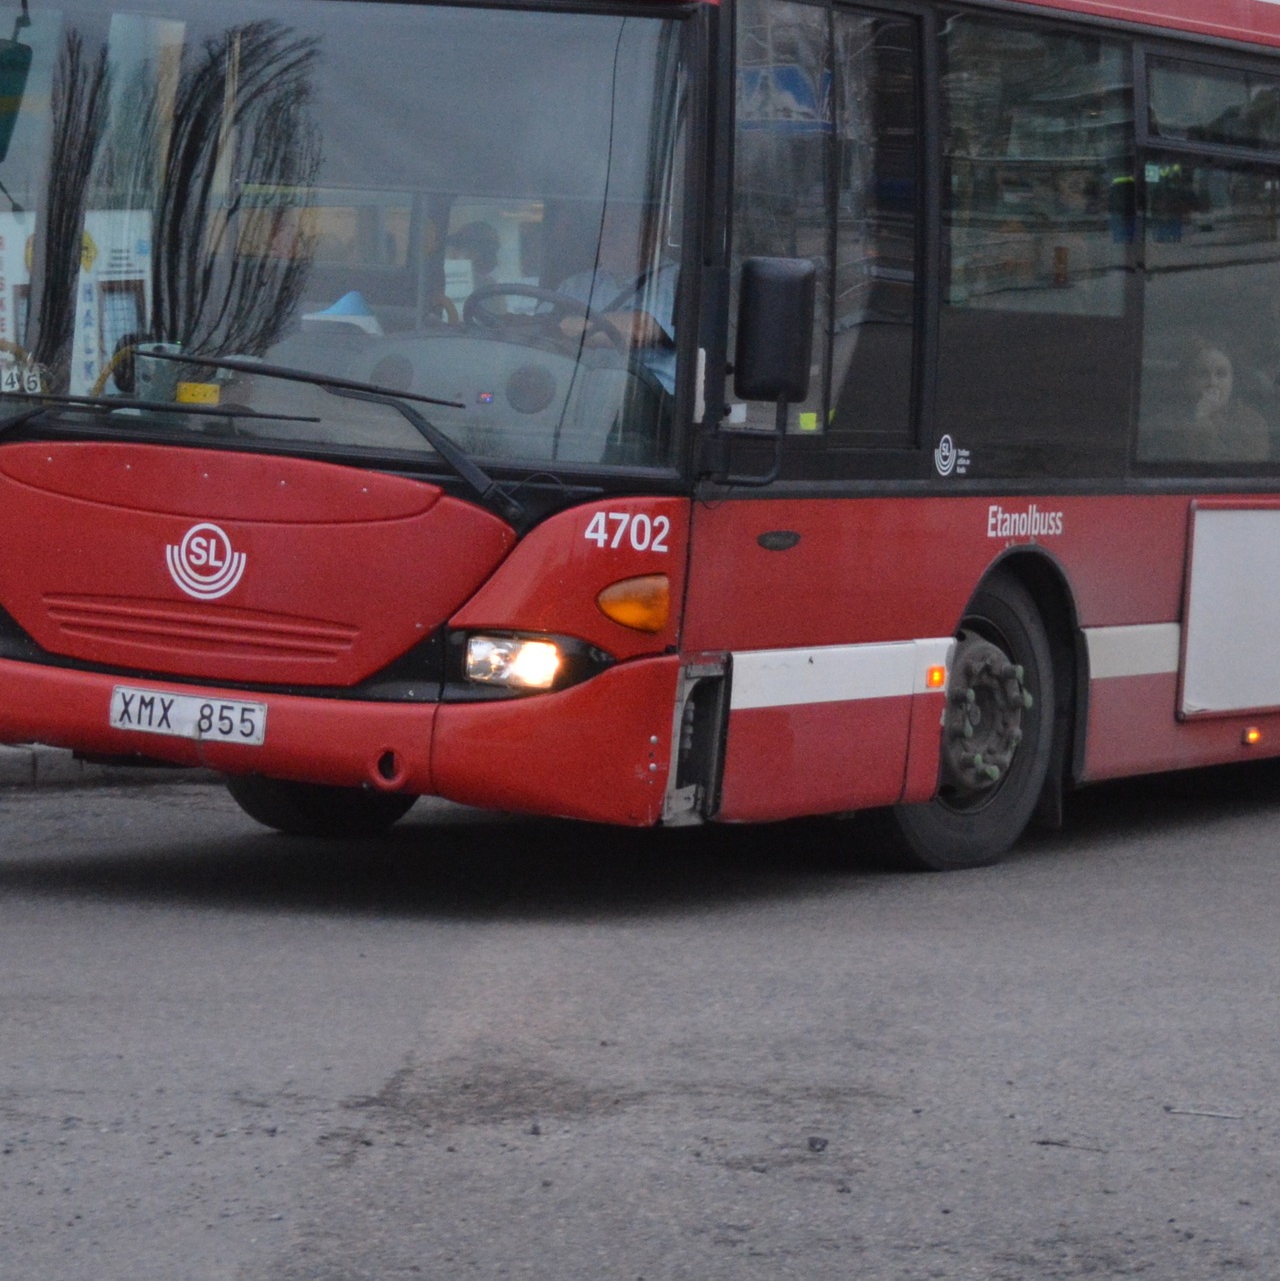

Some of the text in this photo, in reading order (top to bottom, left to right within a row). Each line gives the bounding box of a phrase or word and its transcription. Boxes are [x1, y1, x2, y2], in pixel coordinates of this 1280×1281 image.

[584, 511, 670, 553] 4702
[987, 504, 1063, 537] Etanolbuss
[189, 537, 223, 567] SL
[119, 692, 256, 737] XMX 855
